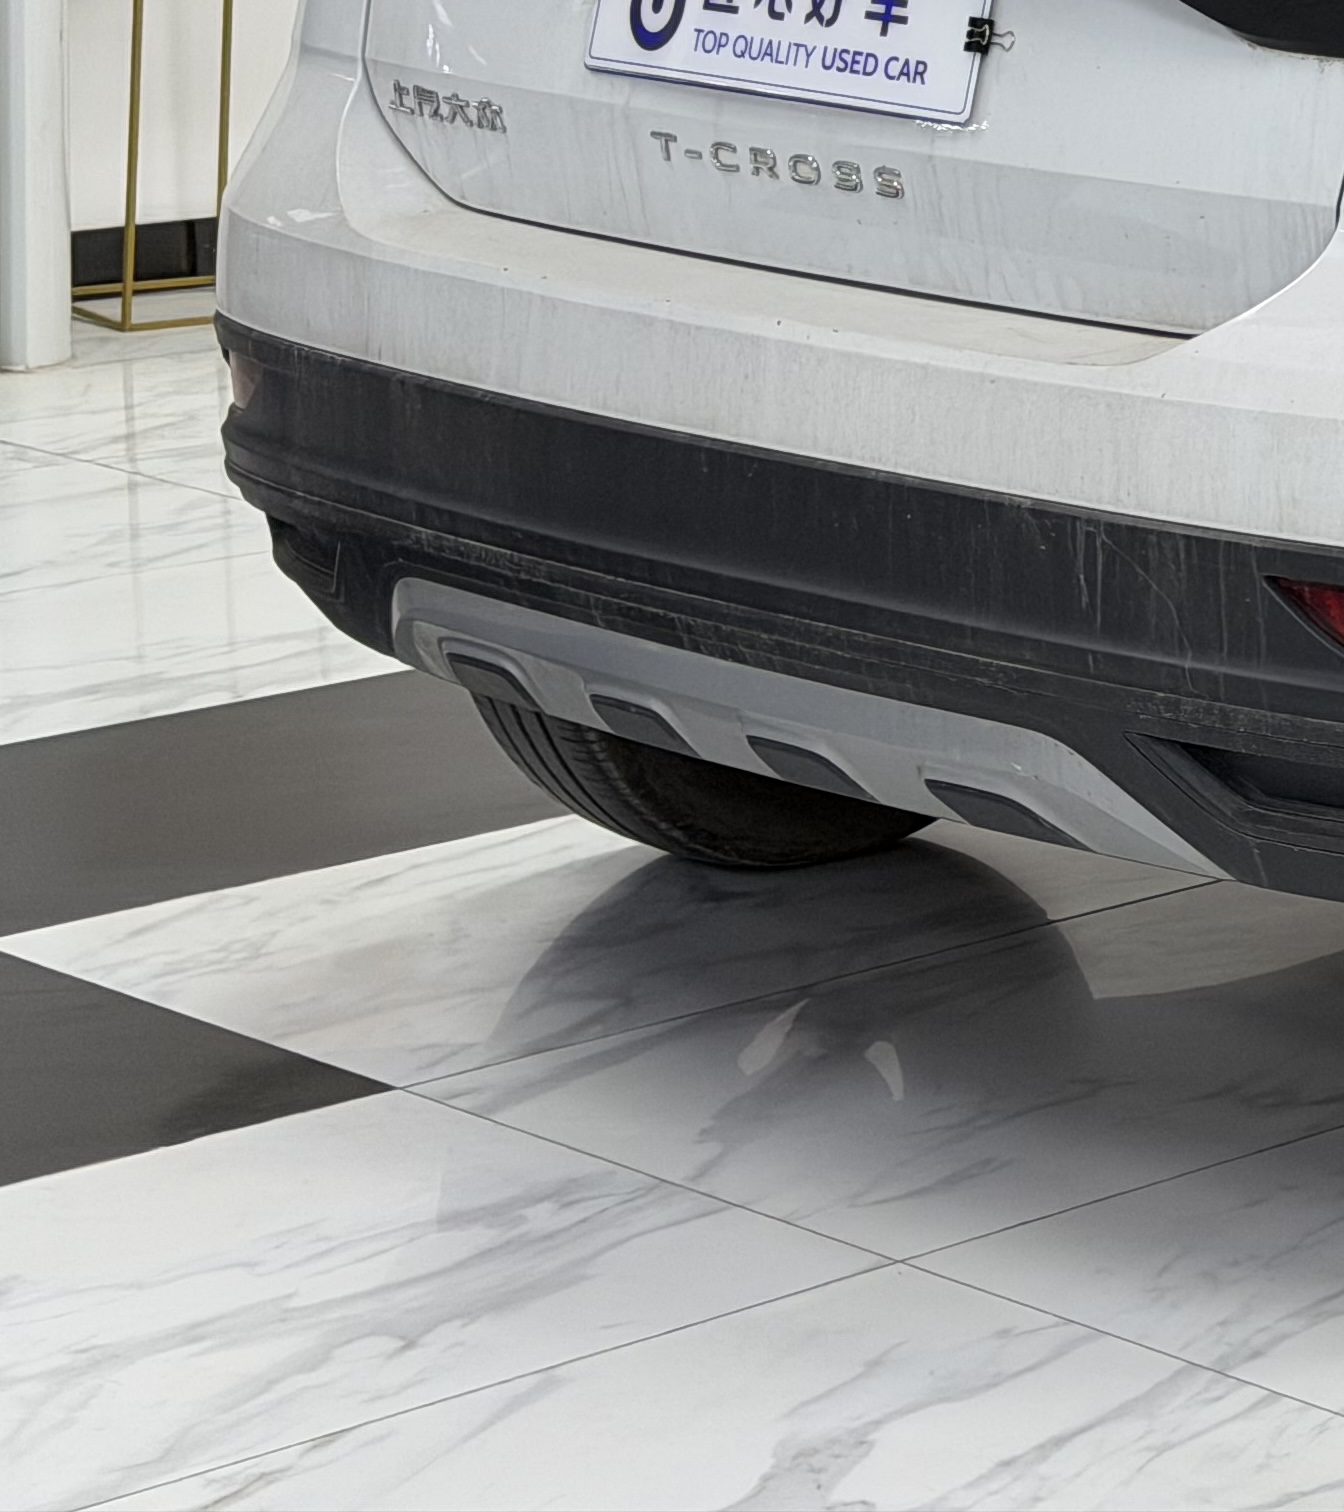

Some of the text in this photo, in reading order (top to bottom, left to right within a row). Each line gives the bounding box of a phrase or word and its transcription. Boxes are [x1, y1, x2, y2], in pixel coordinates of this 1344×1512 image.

[693, 28, 929, 86] TOP QUALITY USED CAR
[649, 130, 904, 199] T-CROSS
